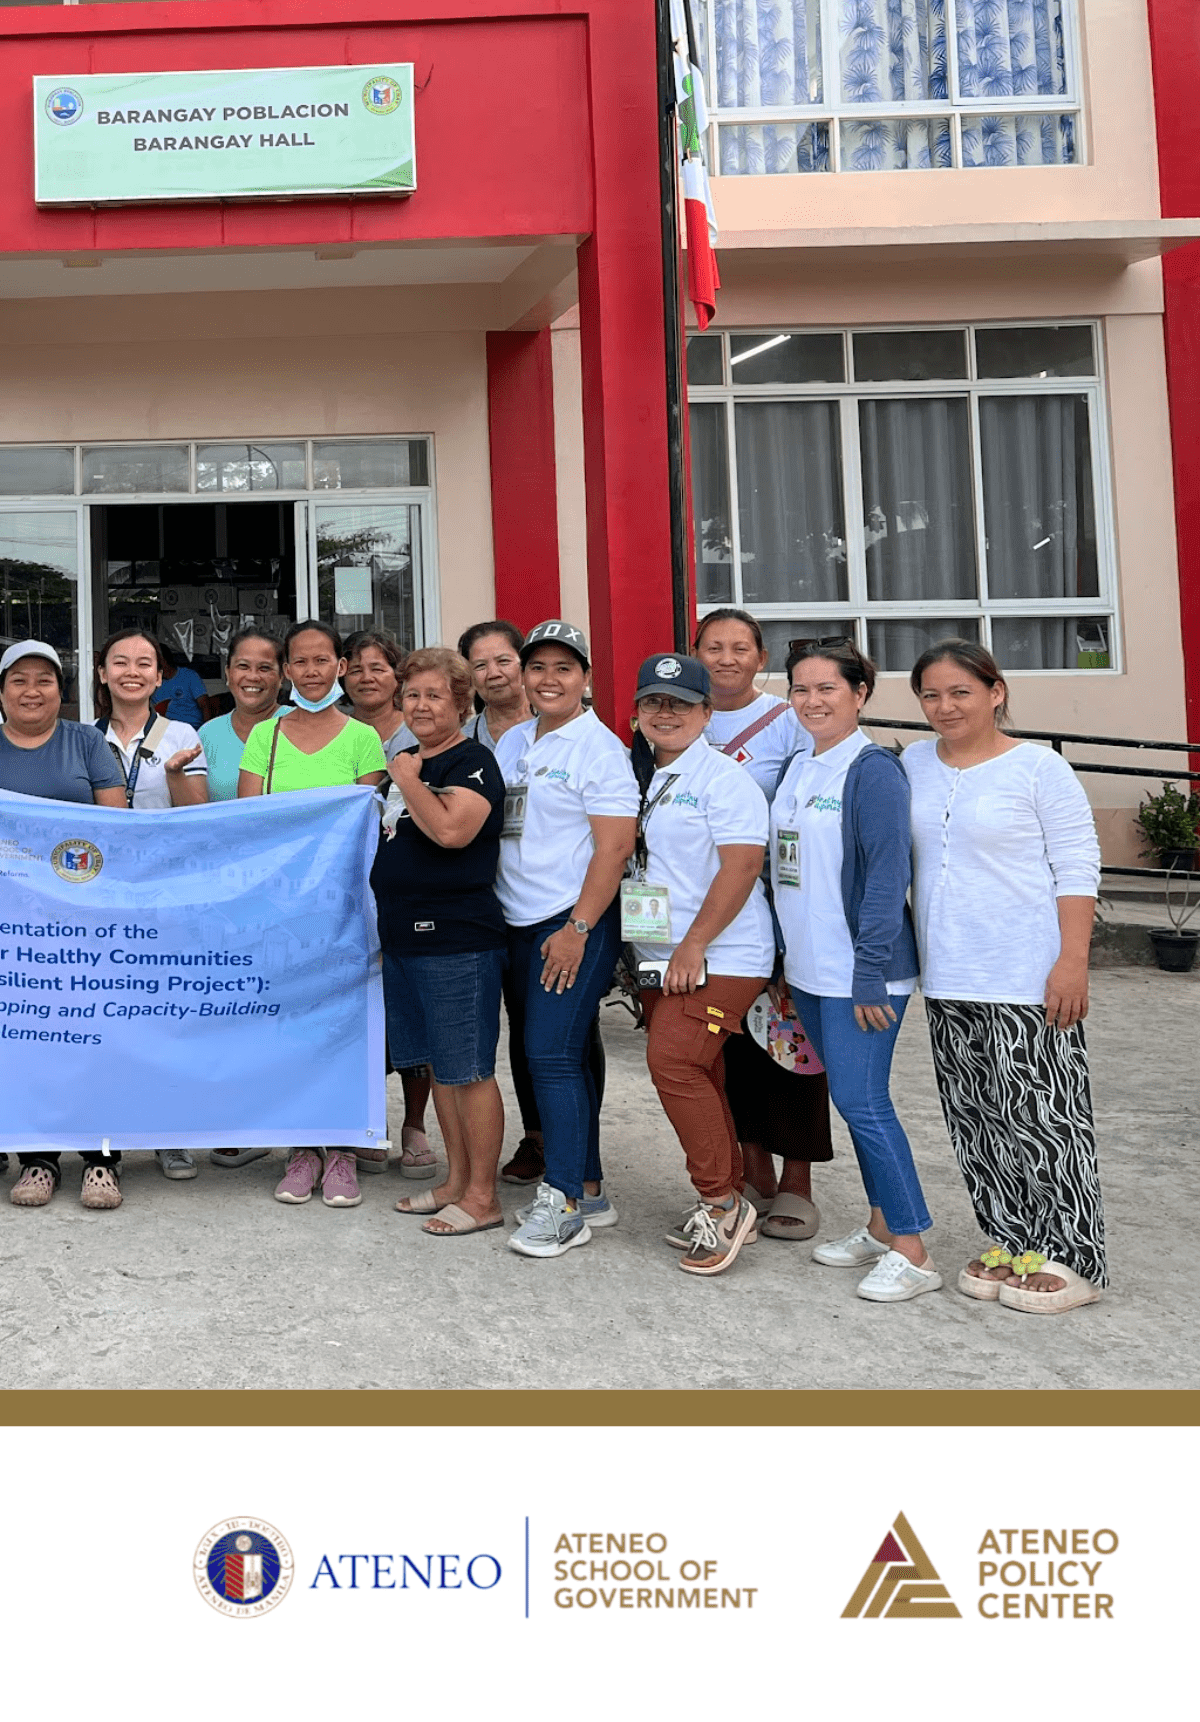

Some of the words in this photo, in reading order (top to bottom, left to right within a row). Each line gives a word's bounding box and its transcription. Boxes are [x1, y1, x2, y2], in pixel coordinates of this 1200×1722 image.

[98, 108, 216, 124] BARANGAY
[223, 103, 348, 120] POBLACION
[134, 135, 253, 151] BARANGAY
[260, 133, 315, 147] HALL
[529, 624, 581, 643] FOX
[95, 924, 117, 938] of
[123, 924, 158, 939] the
[17, 946, 101, 967] Healthy
[109, 949, 253, 966] Communities
[71, 974, 159, 994] Housing
[168, 976, 270, 995] Project”):
[58, 1003, 96, 1018] and
[103, 1001, 281, 1020] Capacity-Building
